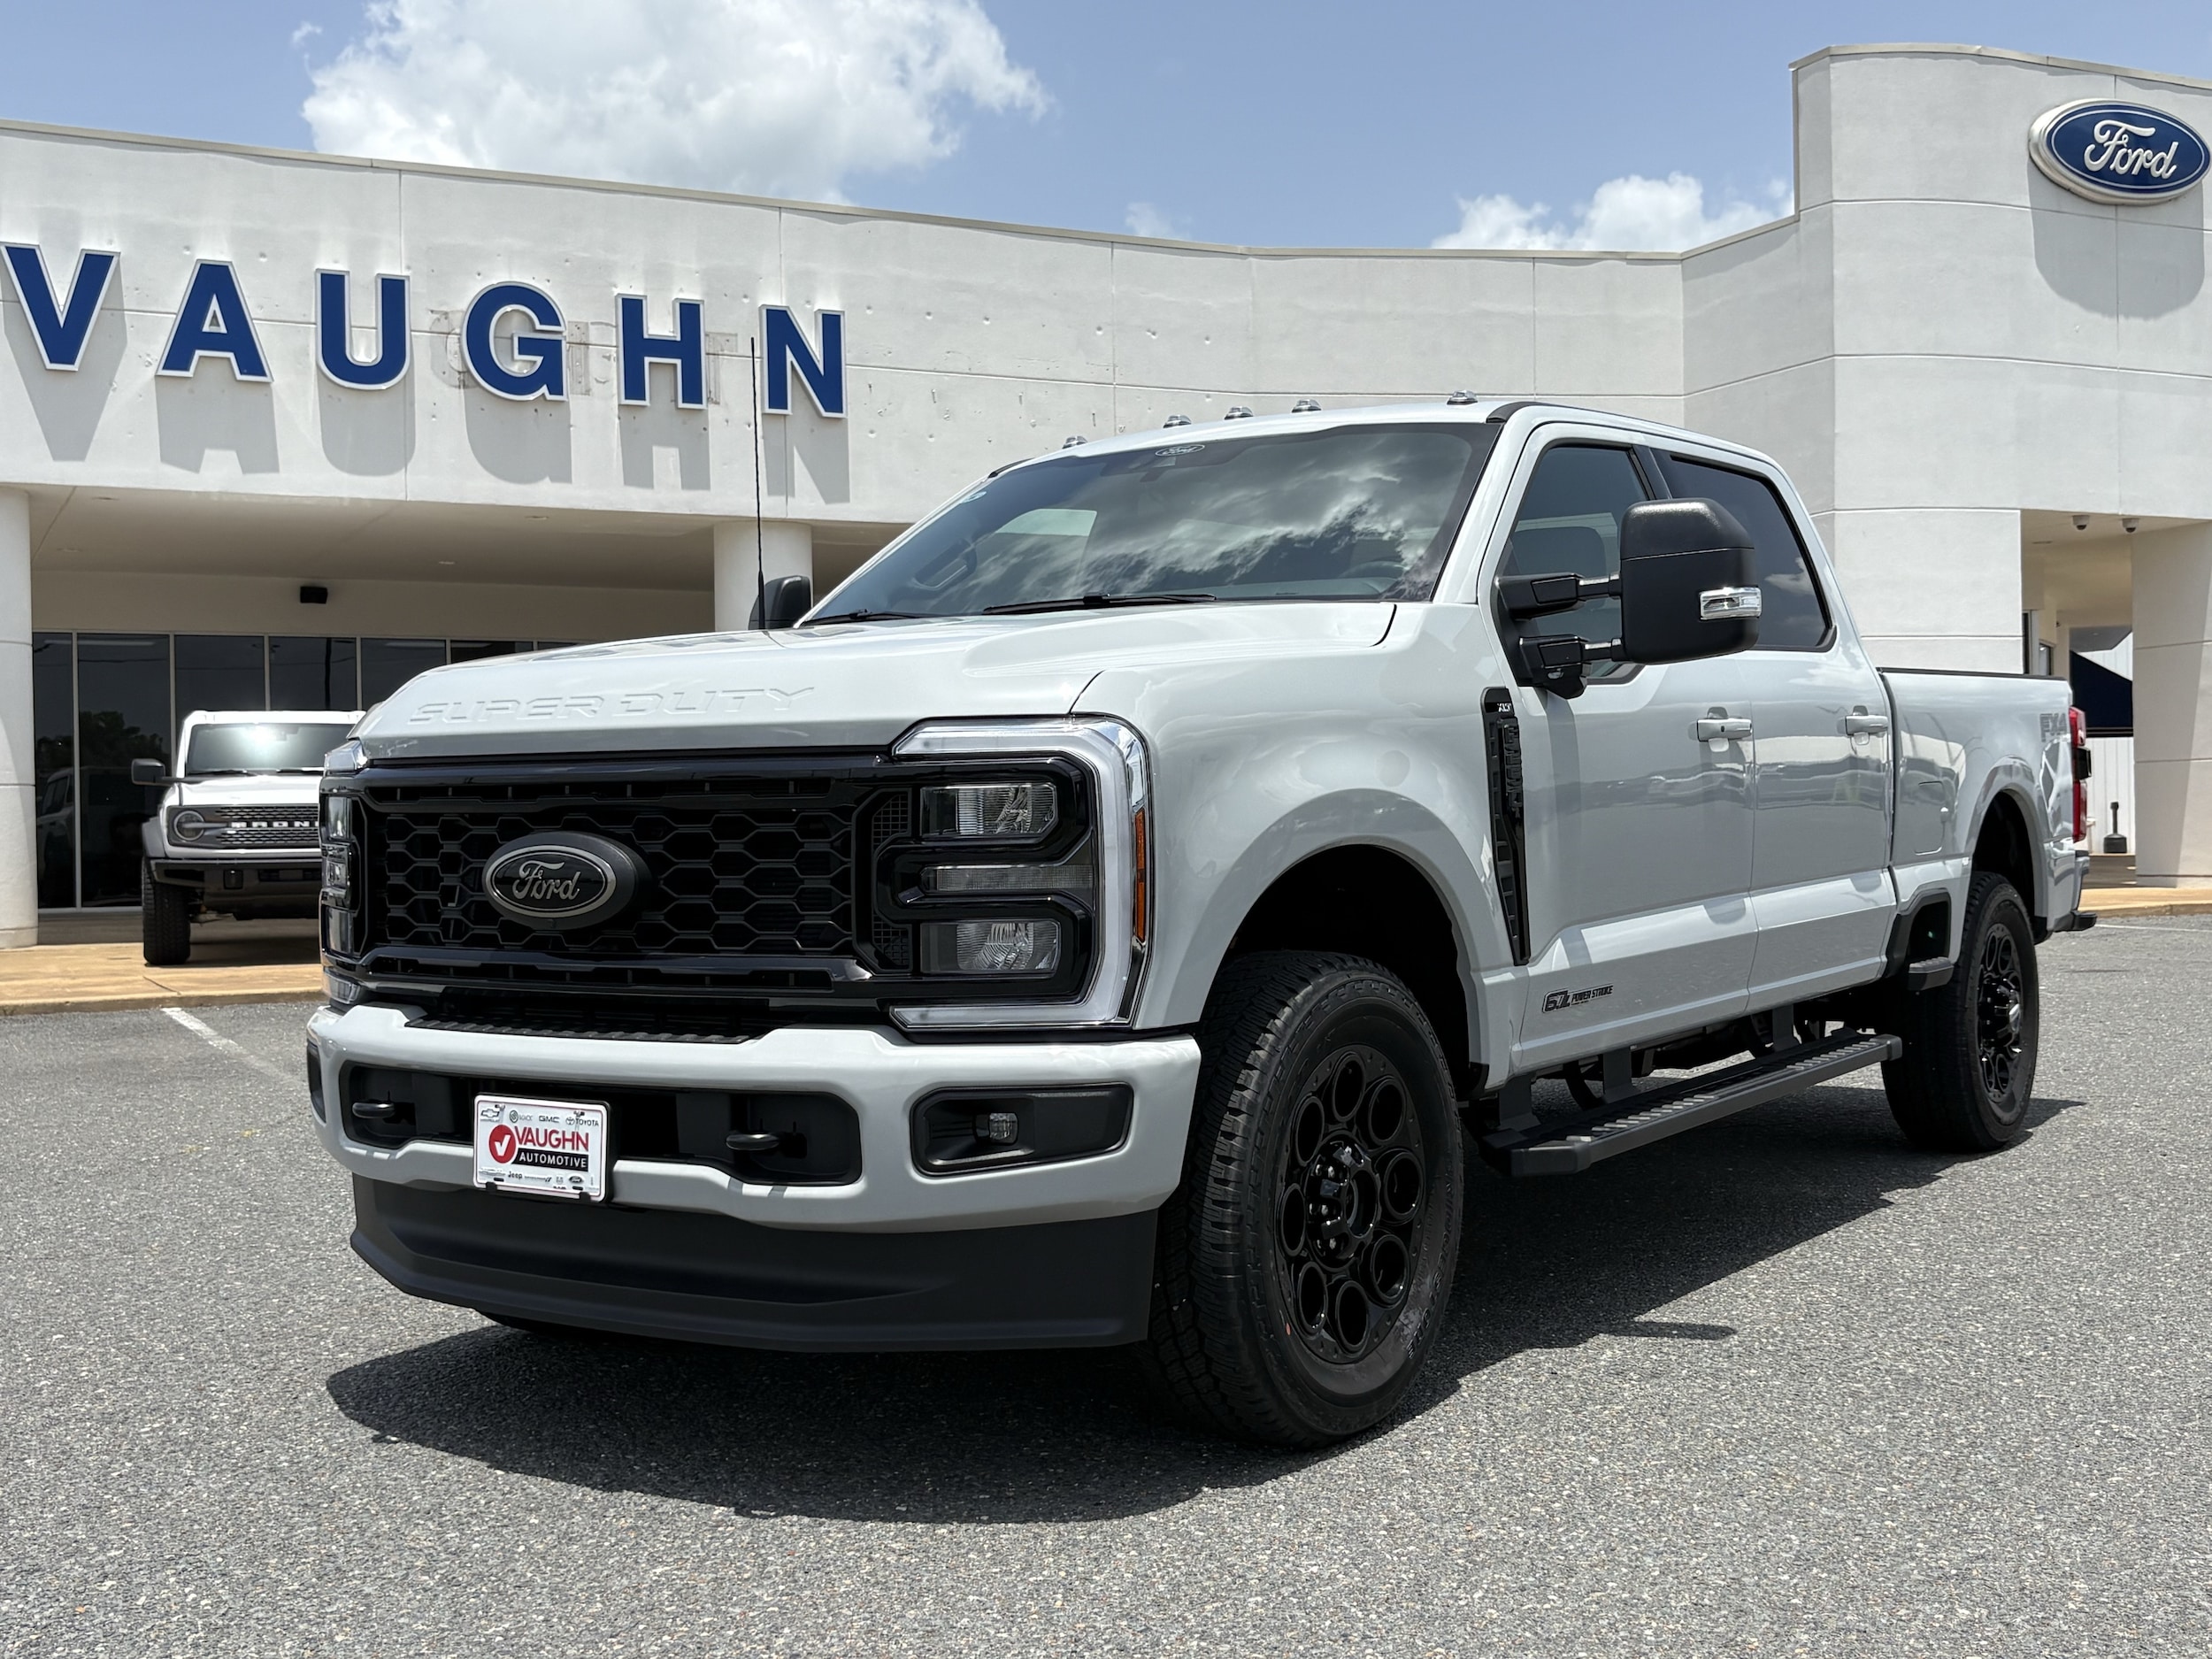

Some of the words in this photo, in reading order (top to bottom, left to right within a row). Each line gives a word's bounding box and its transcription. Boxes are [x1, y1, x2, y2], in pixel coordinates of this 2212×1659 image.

[2084, 119, 2179, 180] Ford
[1, 242, 847, 419] VAUGHN
[408, 695, 605, 724] SUPER
[613, 687, 814, 717] DUTY
[2039, 712, 2068, 742] FX4
[512, 860, 581, 900] Ford
[1571, 990, 1592, 1003] POWER
[1592, 986, 1614, 998] STROKE
[538, 1115, 560, 1124] GMC
[575, 1118, 599, 1127] TOYOTA
[514, 1125, 589, 1152] VAUGHN
[518, 1151, 587, 1168] AUTOMOTIVE
[508, 1171, 523, 1180] Jeep
